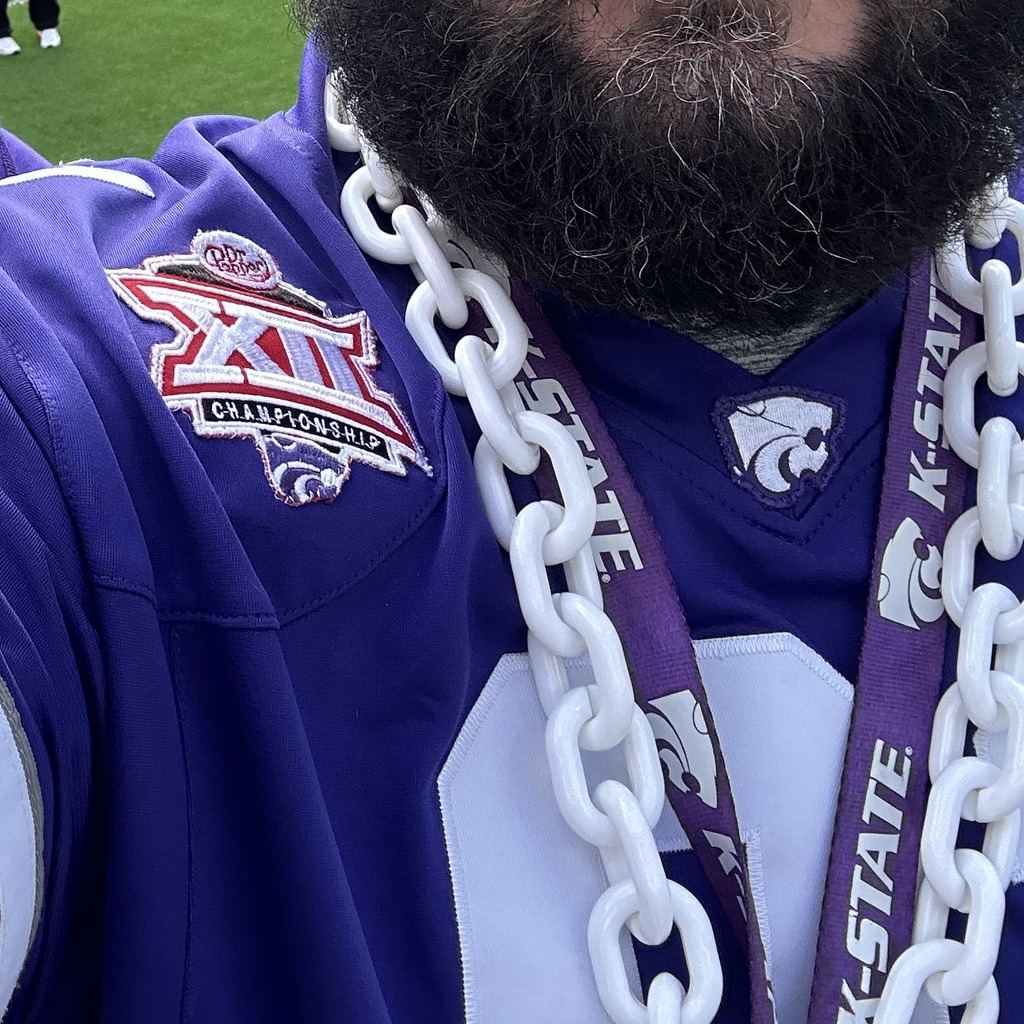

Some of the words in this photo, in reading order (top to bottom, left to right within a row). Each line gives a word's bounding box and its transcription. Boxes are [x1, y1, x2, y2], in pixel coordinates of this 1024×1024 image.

[136, 283, 404, 437] XII
[211, 399, 382, 451] CHAMPIONSHIP
[907, 255, 962, 514] K-STAT
